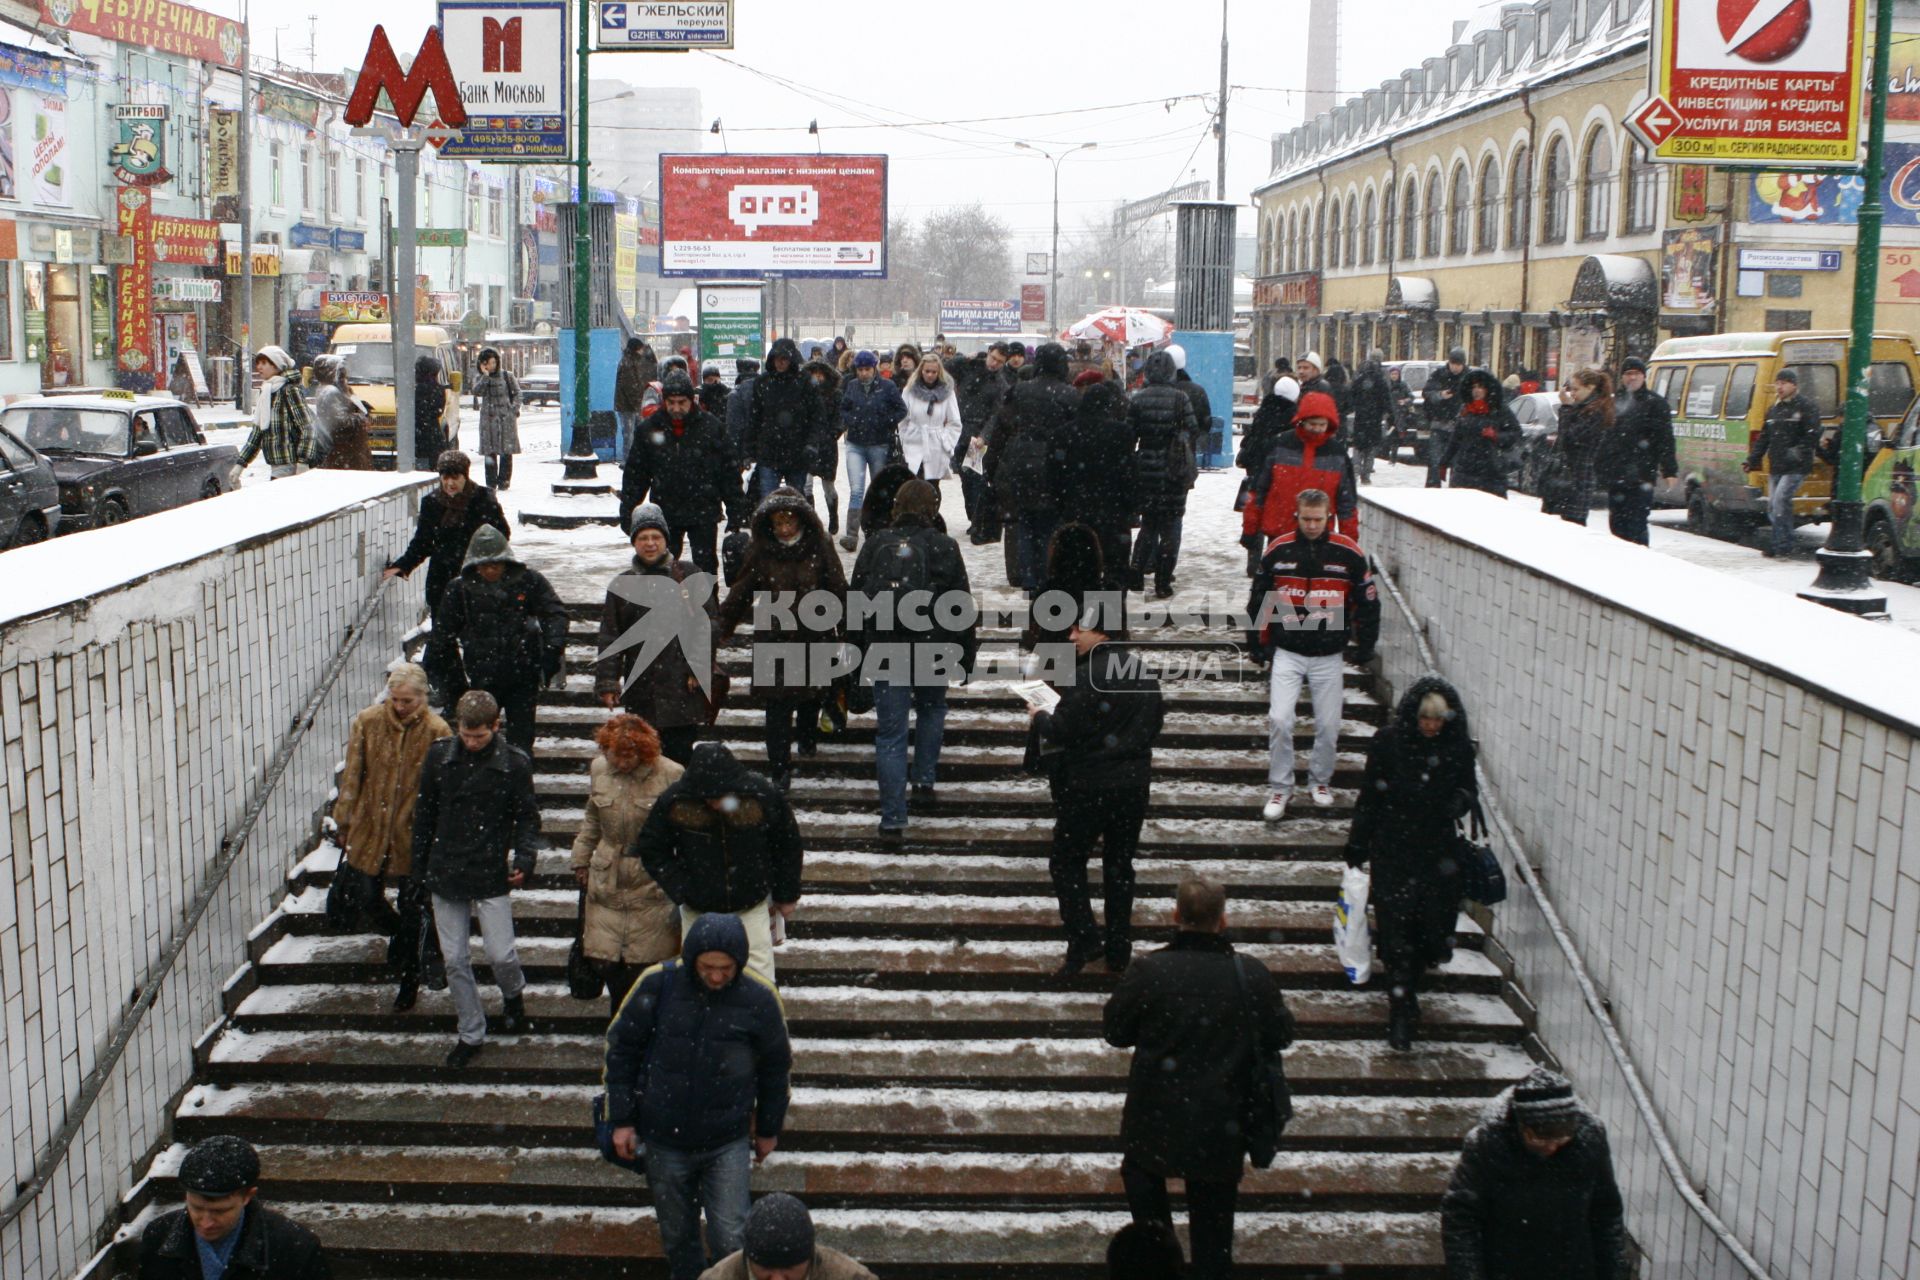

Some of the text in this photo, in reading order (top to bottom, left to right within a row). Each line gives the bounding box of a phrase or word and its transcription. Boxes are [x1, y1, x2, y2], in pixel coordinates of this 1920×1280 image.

[637, 4, 725, 17] ГЖЕЛЬСКИЙ
[677, 19, 724, 28] переулок
[687, 32, 723, 40] side-street
[1690, 77, 1835, 92] КРЕДИТНЫЕ КАРТЫ
[459, 80, 545, 104] Банк Москвы
[118, 105, 164, 117] ЛИТРБОЛ
[1678, 97, 1844, 113] ИНВЕСТИЦИИ КРЕДИТЫ
[1685, 117, 1842, 133] УСЛУГИ ДЛЯ БИЗНЕСА
[33, 131, 55, 159] ЦЕНЫ
[471, 135, 494, 144] (495)
[526, 145, 562, 153] РИМСКАЯ
[1675, 140, 1700, 152] 300
[1731, 142, 1764, 153] СЕРГИЯ
[672, 165, 745, 176] Компьютерный
[747, 167, 786, 175] магазин
[796, 167, 836, 175] низкими
[839, 168, 875, 176] ценами
[740, 191, 807, 214] ого!
[1825, 255, 1832, 266] 1
[1886, 254, 1912, 265] 50
[120, 209, 136, 348] ЧЕРЕЧНАЯ
[213, 282, 222, 300] 2
[328, 293, 380, 304] БИСТРО
[941, 309, 1020, 320] ПАРИКМАХЕРСКАЯ
